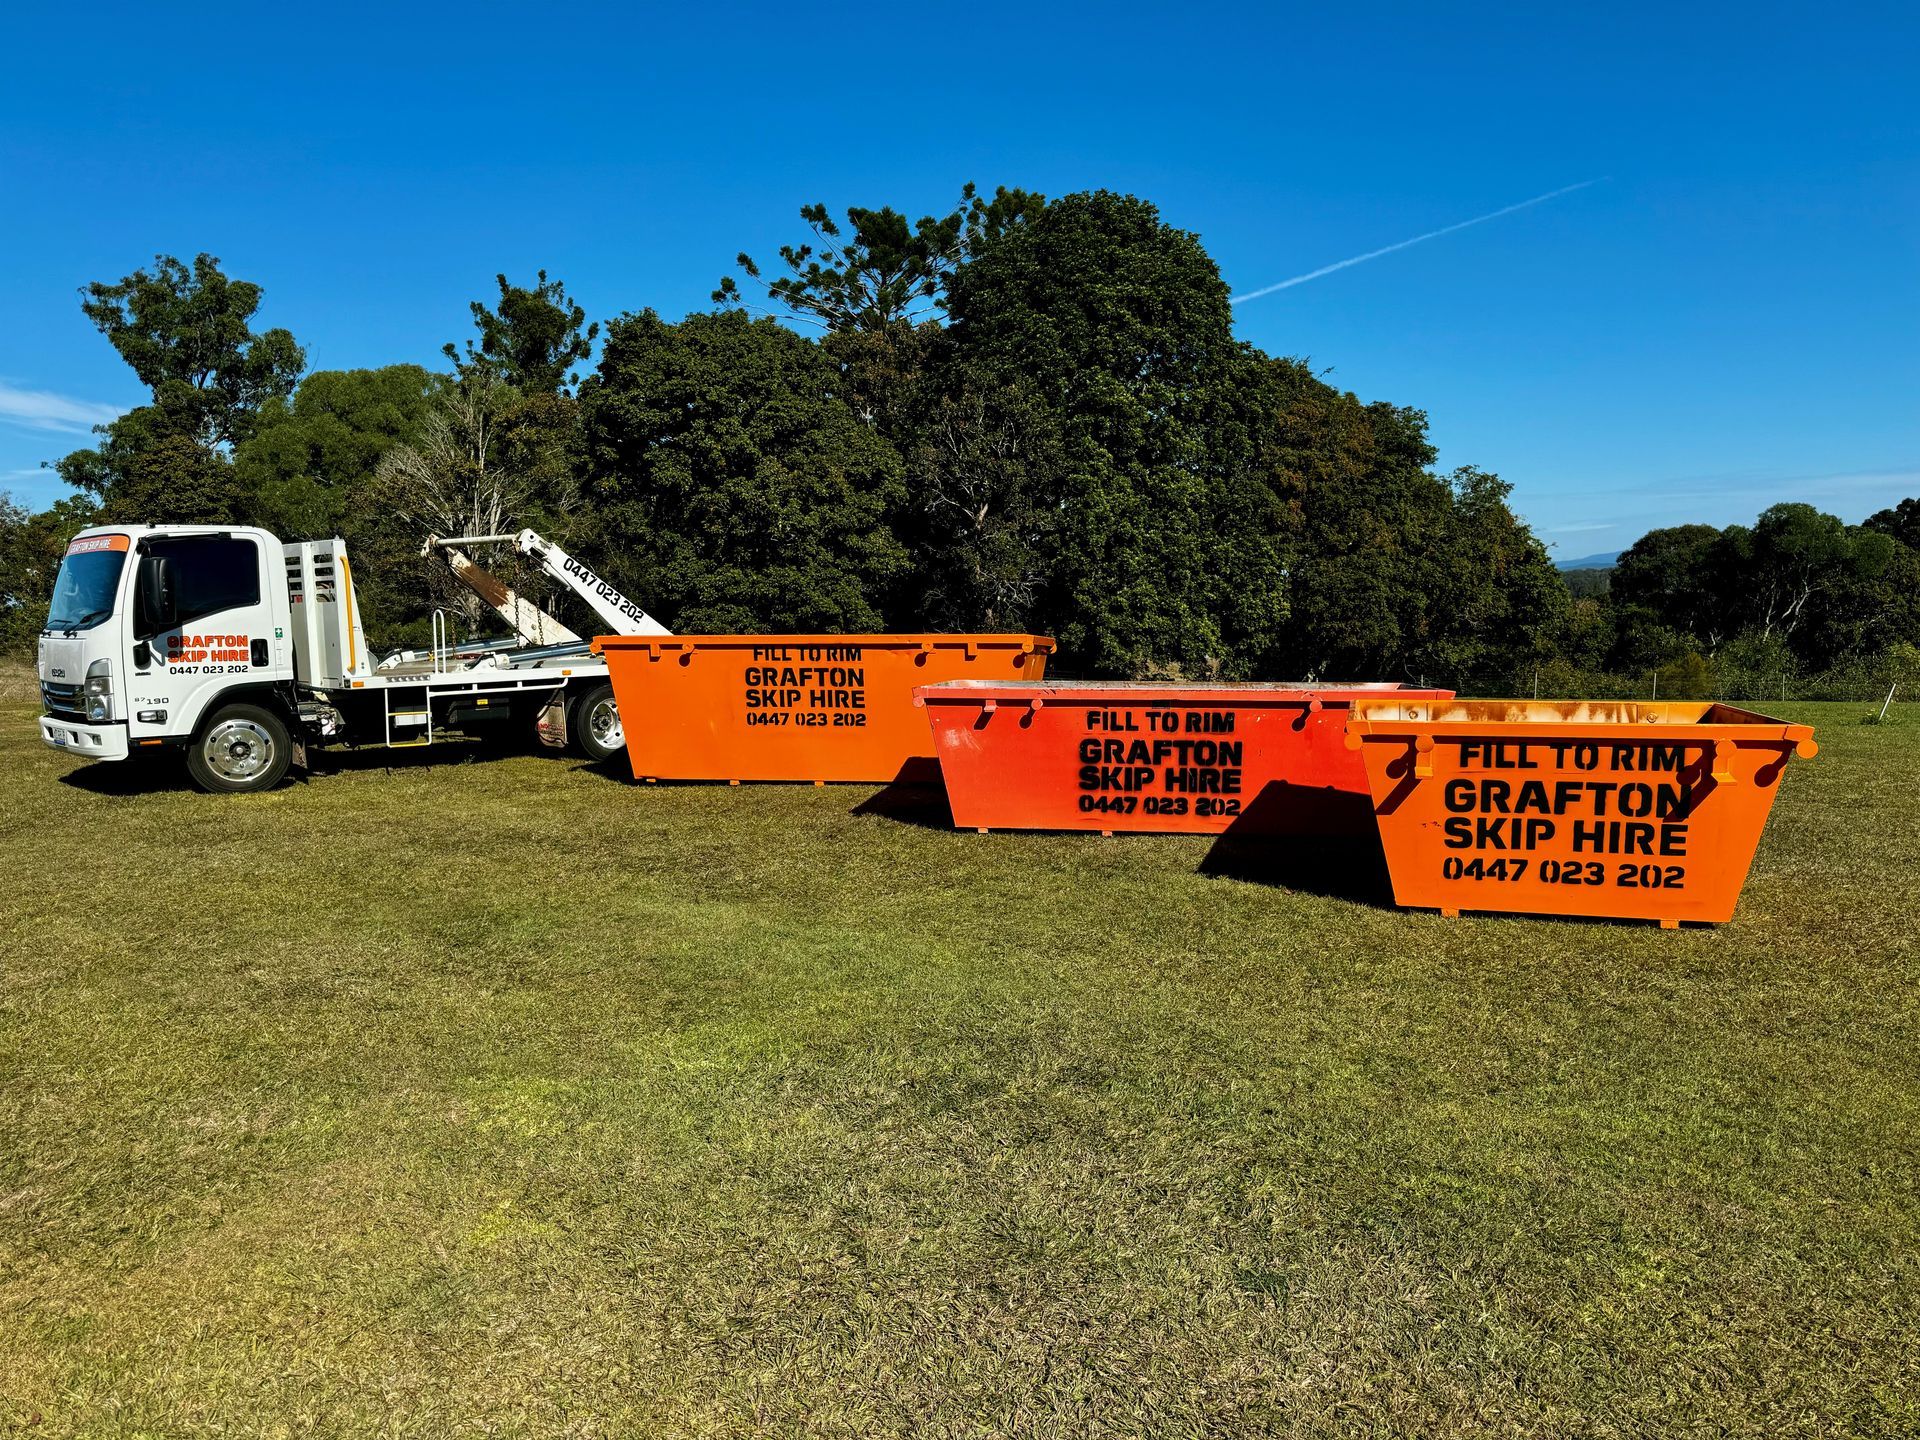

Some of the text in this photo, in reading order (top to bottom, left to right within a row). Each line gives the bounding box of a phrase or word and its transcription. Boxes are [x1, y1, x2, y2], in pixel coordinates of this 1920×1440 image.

[563, 558, 644, 624] 0447 023 202
[167, 635, 249, 648] GRAFTON
[168, 650, 249, 663] SKIP HIRE
[753, 645, 862, 662] FILL TO RIM
[169, 665, 249, 675] 0447 023 202
[745, 667, 864, 687] GRAFTON
[746, 689, 865, 708] SKIP HIRE
[746, 712, 866, 726] 0447 023 202
[1087, 711, 1235, 733] FILL TO RIM
[1079, 738, 1242, 766] GRAFTON
[1459, 741, 1686, 772] FILL TO RIM
[1079, 766, 1242, 794] SKIP HIRE
[1079, 795, 1241, 816] 0447 023 202
[1444, 778, 1692, 818] GRAFTON
[1444, 817, 1689, 856] SKIP HIRE
[1443, 857, 1685, 888] 0447 023 202
